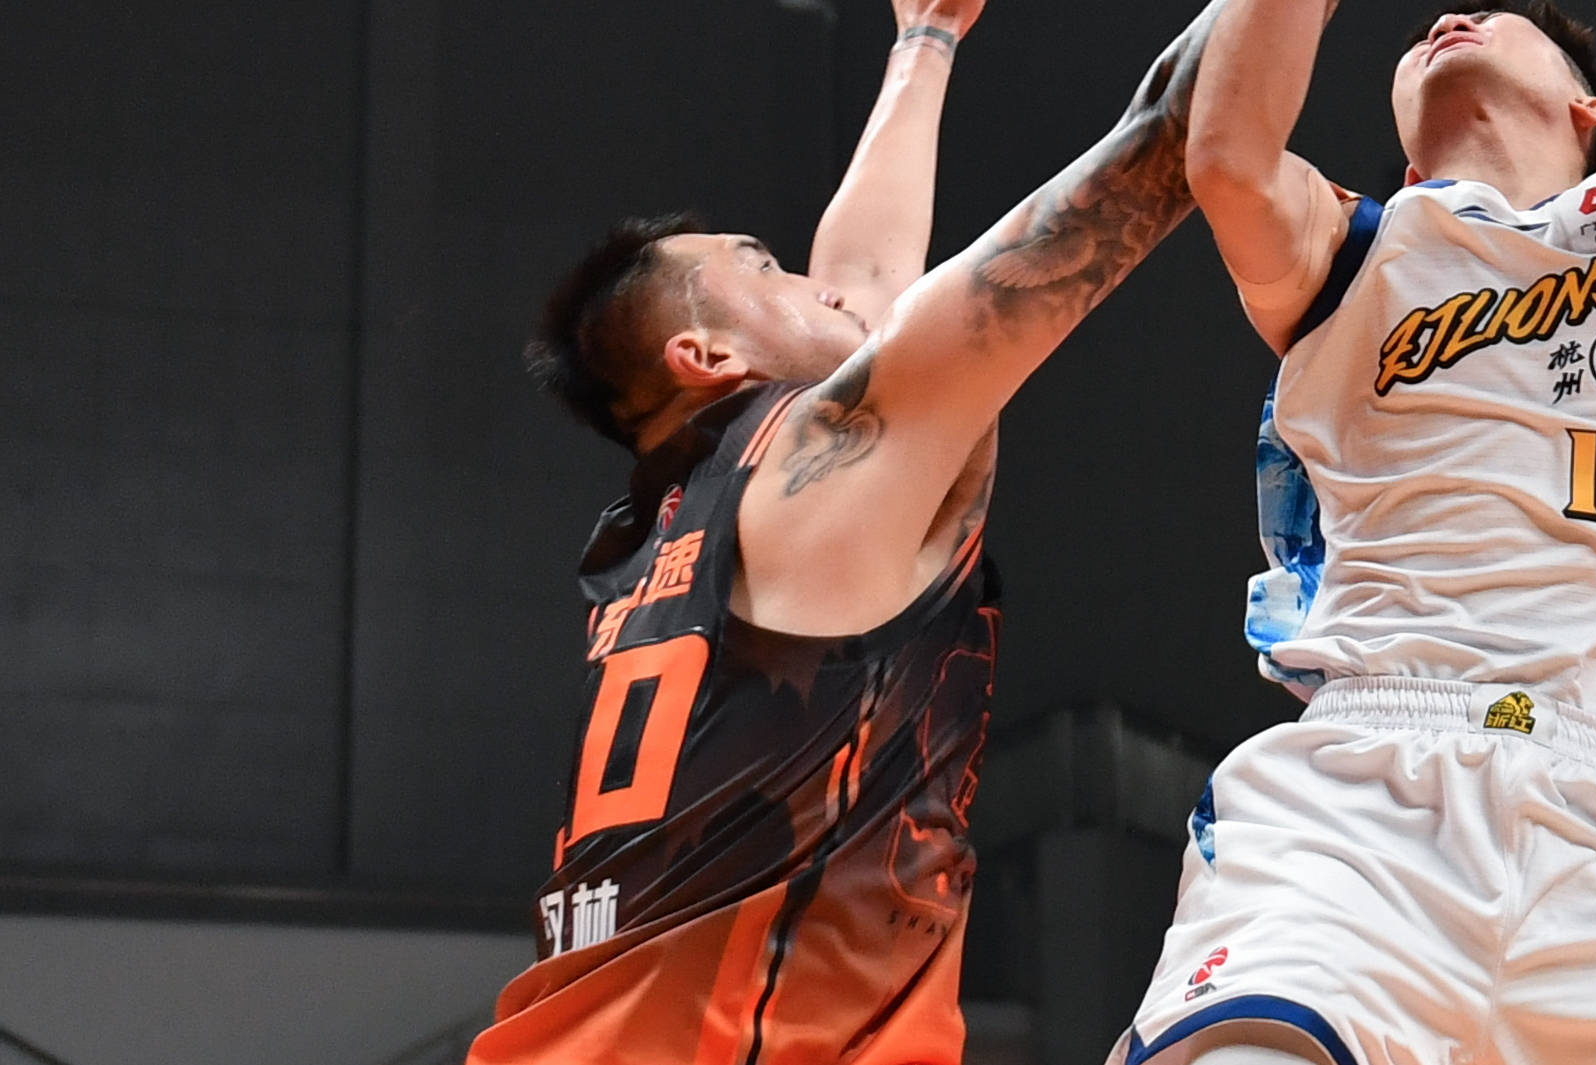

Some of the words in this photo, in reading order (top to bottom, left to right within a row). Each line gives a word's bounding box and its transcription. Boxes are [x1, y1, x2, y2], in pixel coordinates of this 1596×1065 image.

[1547, 340, 1586, 405] 杭州
[553, 634, 709, 872] 0
[1185, 983, 1217, 1002] CBA
